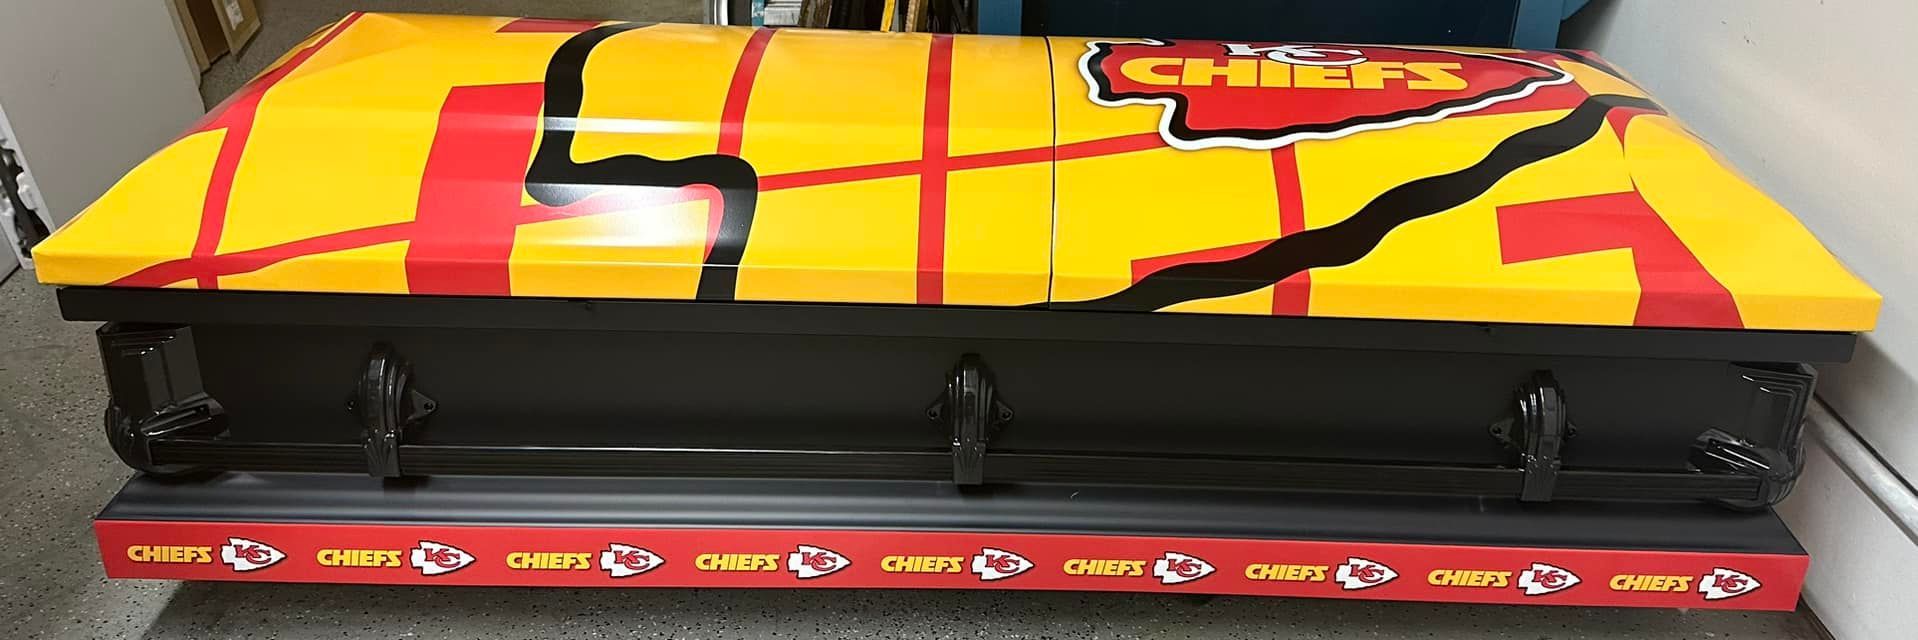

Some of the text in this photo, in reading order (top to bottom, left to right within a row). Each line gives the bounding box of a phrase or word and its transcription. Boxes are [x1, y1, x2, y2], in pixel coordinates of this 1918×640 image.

[1224, 43, 1368, 67] KC
[1119, 57, 1468, 90] CHIEFS
[127, 544, 1748, 593] CHIEFS KC CHIEFS KC CHIEFS KC CHIEFS KC CHIEFS KC CHIEFS KC CHIEFS KC CHIEFS KC CHIEFS KC
